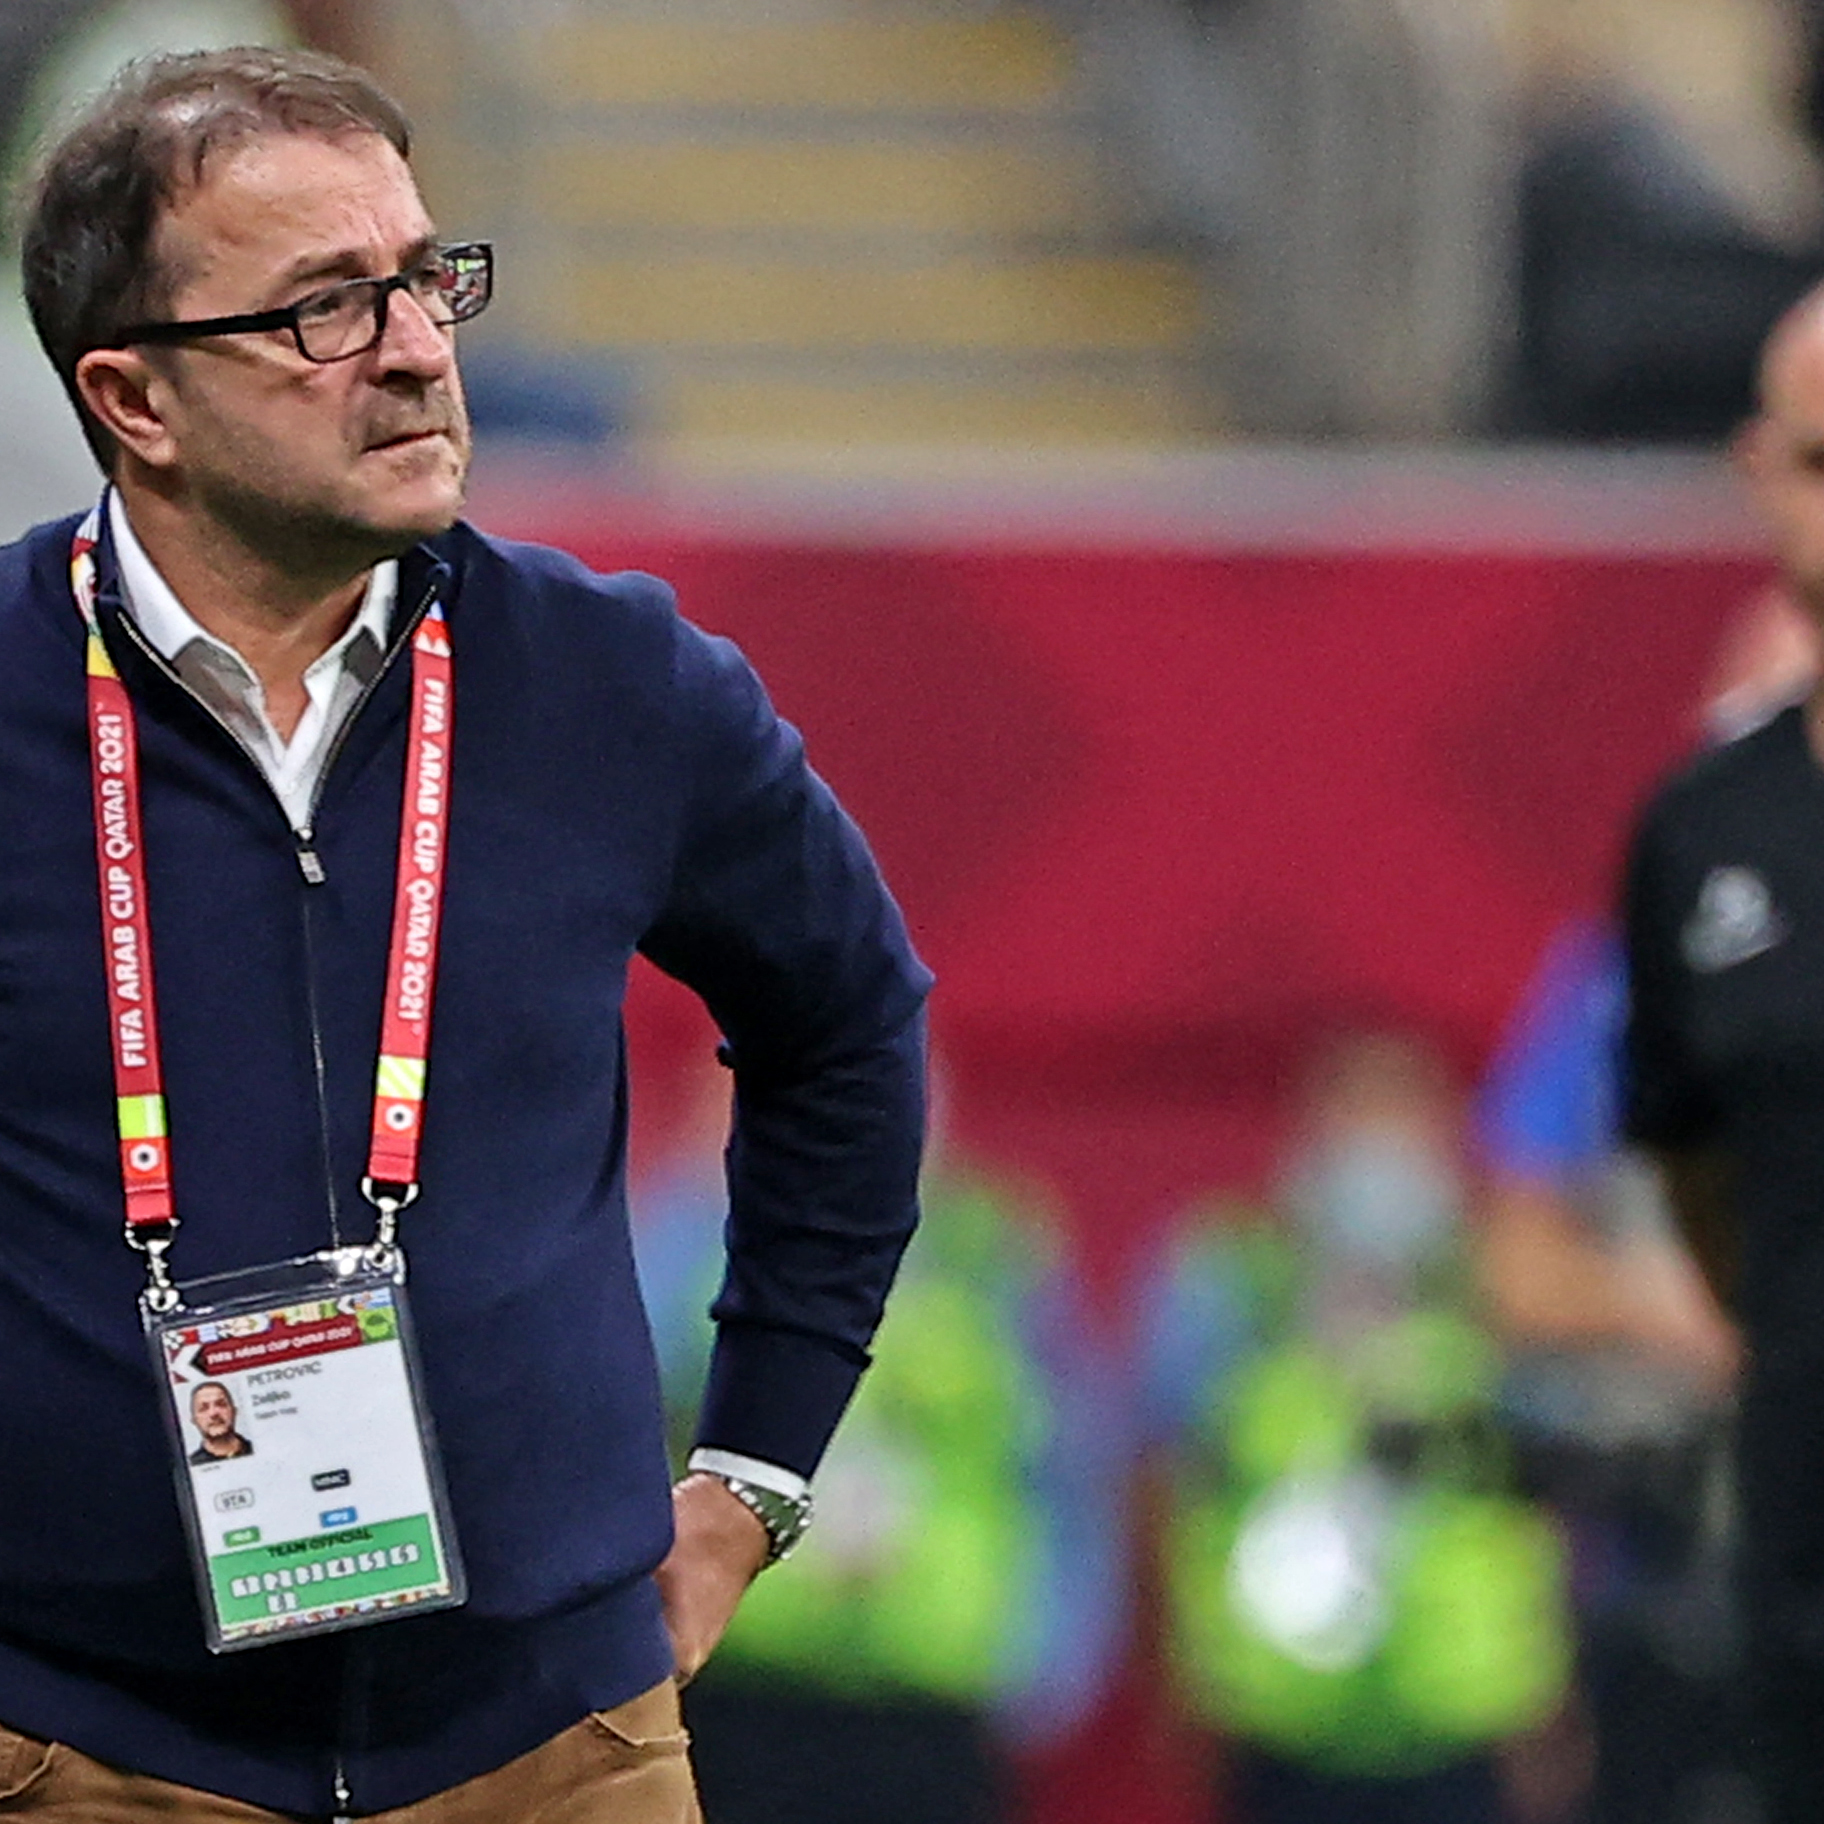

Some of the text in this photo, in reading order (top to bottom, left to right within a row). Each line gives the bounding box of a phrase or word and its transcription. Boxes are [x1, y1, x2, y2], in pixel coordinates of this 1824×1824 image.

[97, 714, 148, 1067] FIFA ARAB CUP QATAR 2021
[398, 678, 446, 1021] FIFA ARAB CUP QATAR 2021
[246, 1360, 323, 1387] PETROVIC
